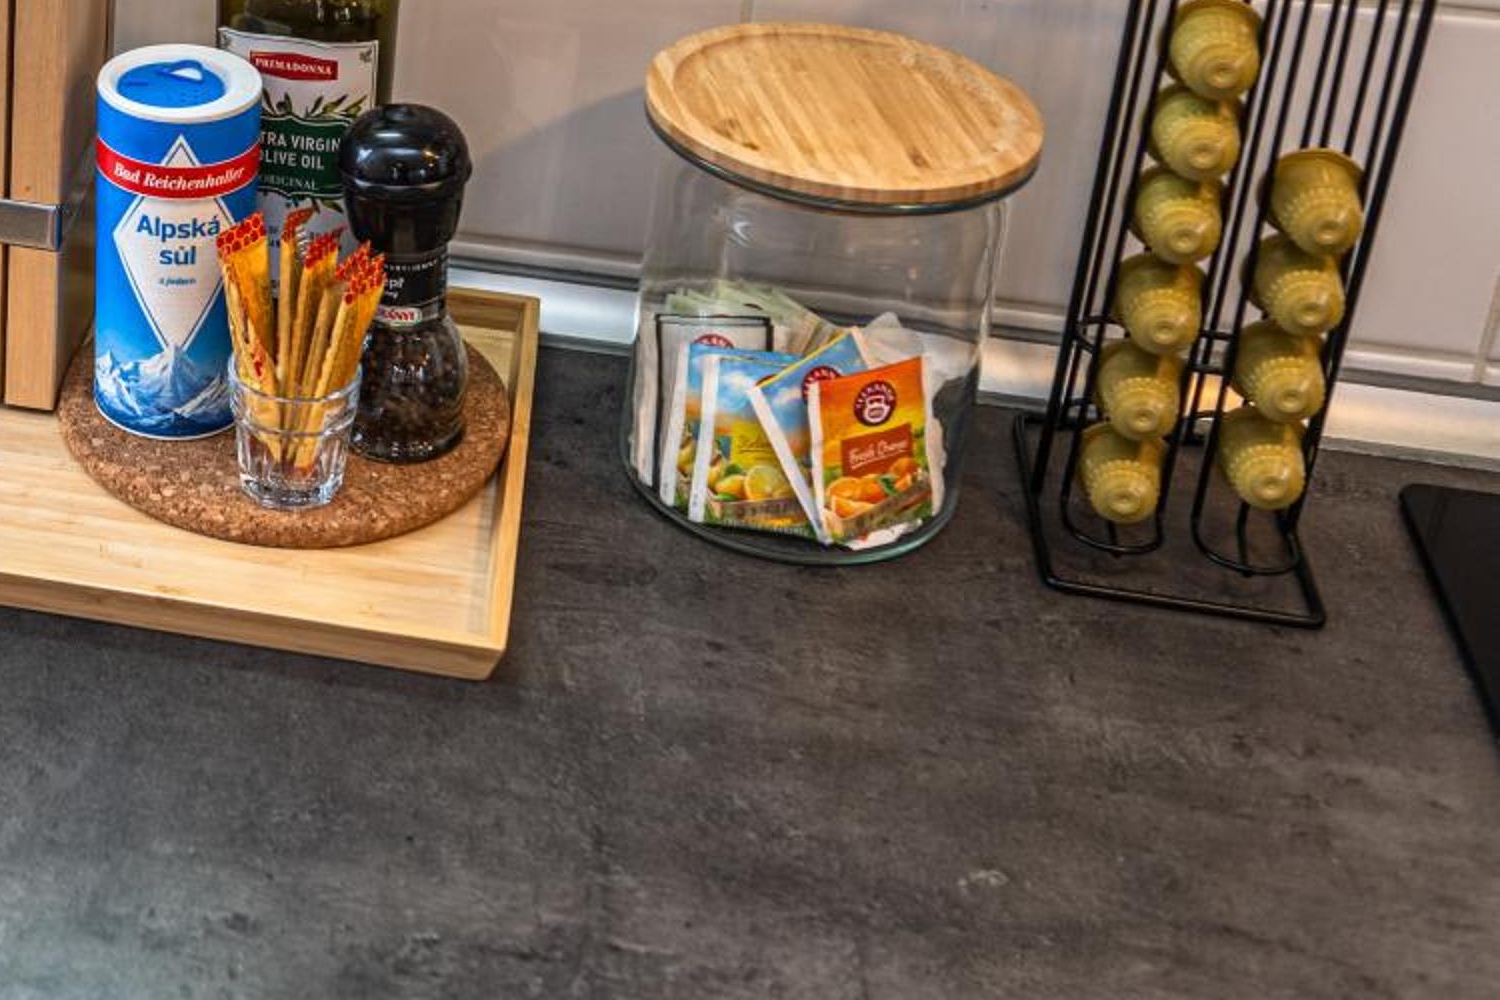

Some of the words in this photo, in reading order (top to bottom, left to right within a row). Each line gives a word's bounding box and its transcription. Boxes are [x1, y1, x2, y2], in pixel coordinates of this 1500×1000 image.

[256, 57, 333, 76] PRIMADONNA
[260, 130, 288, 147] TRA
[291, 135, 342, 153] VIRGIN
[301, 155, 325, 170] OIL
[113, 161, 141, 185] Bad
[144, 165, 246, 191] Reichenhaller
[136, 214, 221, 242] Alpská
